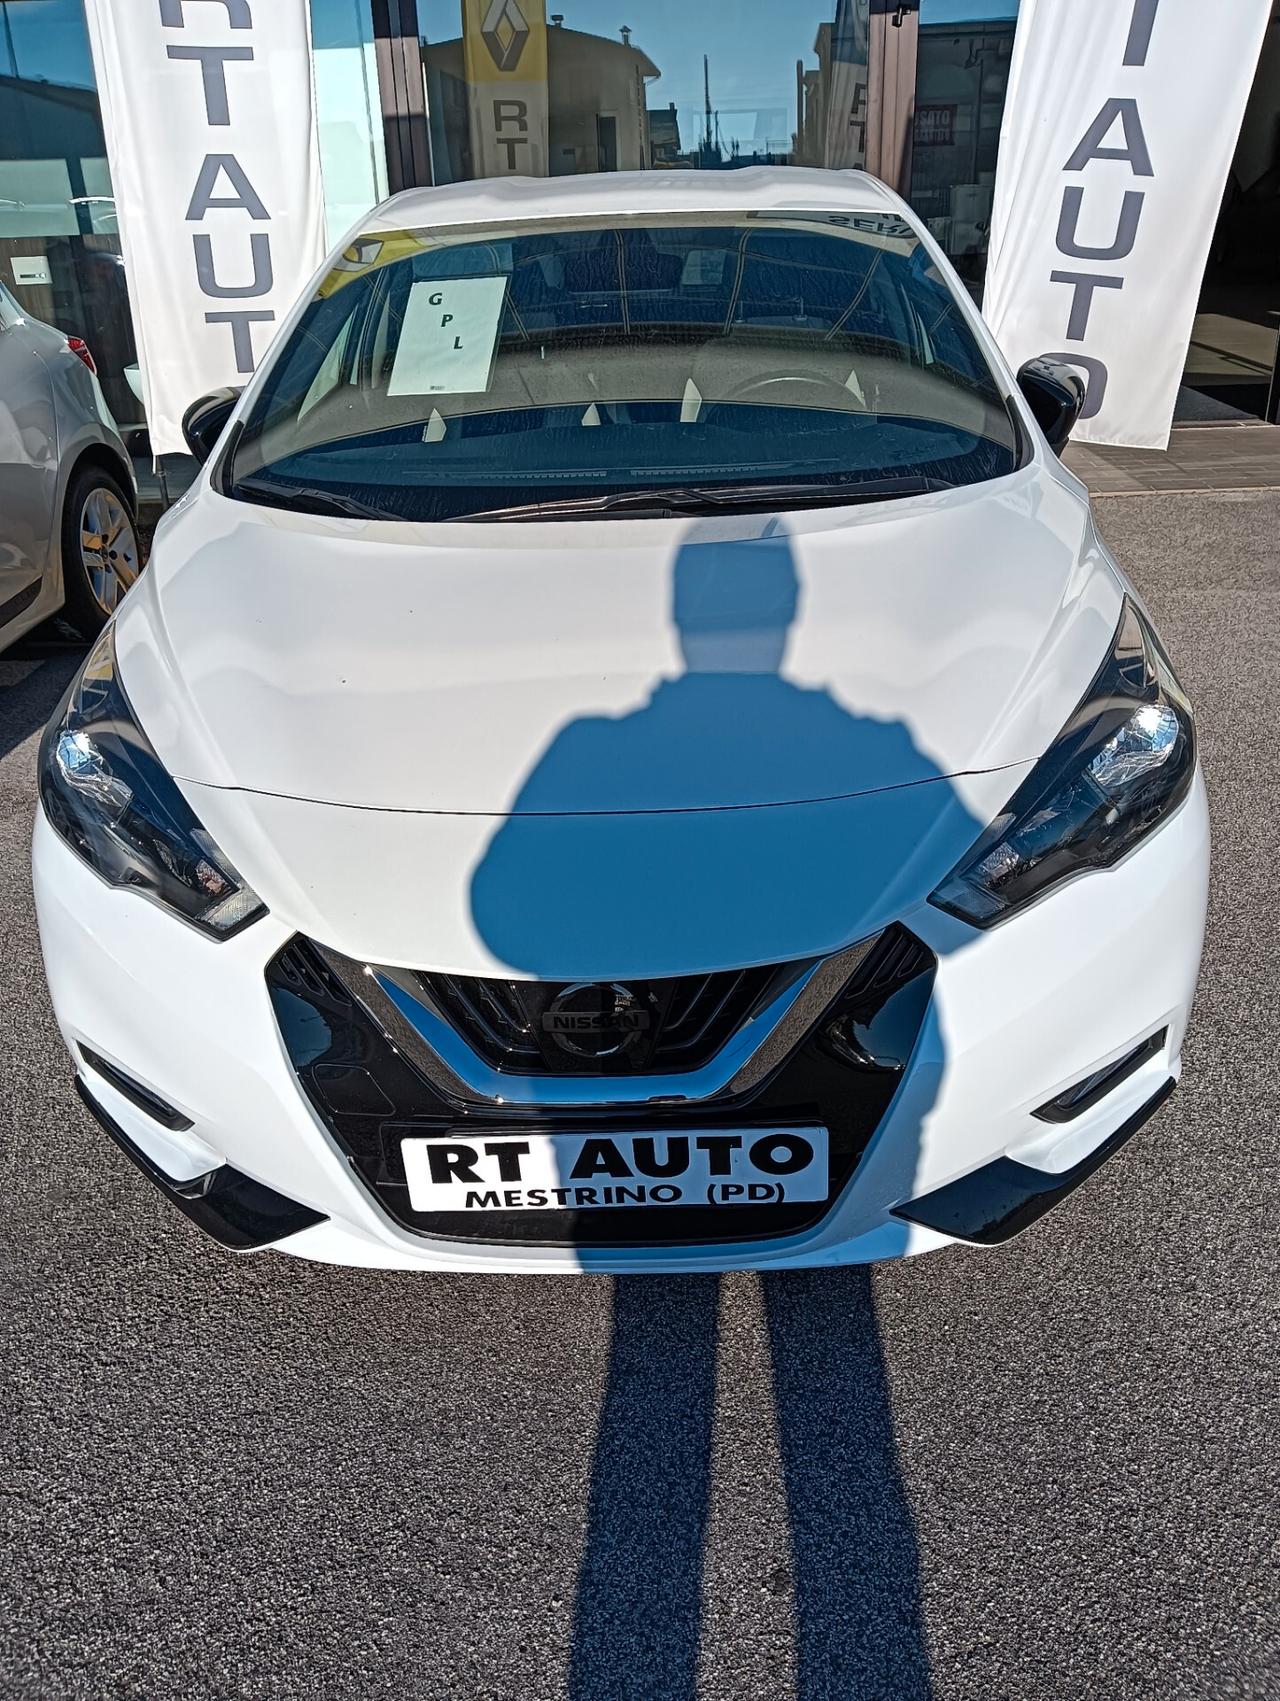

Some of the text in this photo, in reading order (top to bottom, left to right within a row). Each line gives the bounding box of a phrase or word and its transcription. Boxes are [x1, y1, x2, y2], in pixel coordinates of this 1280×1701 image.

[493, 99, 529, 170] RT
[553, 1014, 640, 1030] NISSAN
[426, 1133, 814, 1184] RT AUTO
[465, 1182, 785, 1208] MESTRINO (PD)
